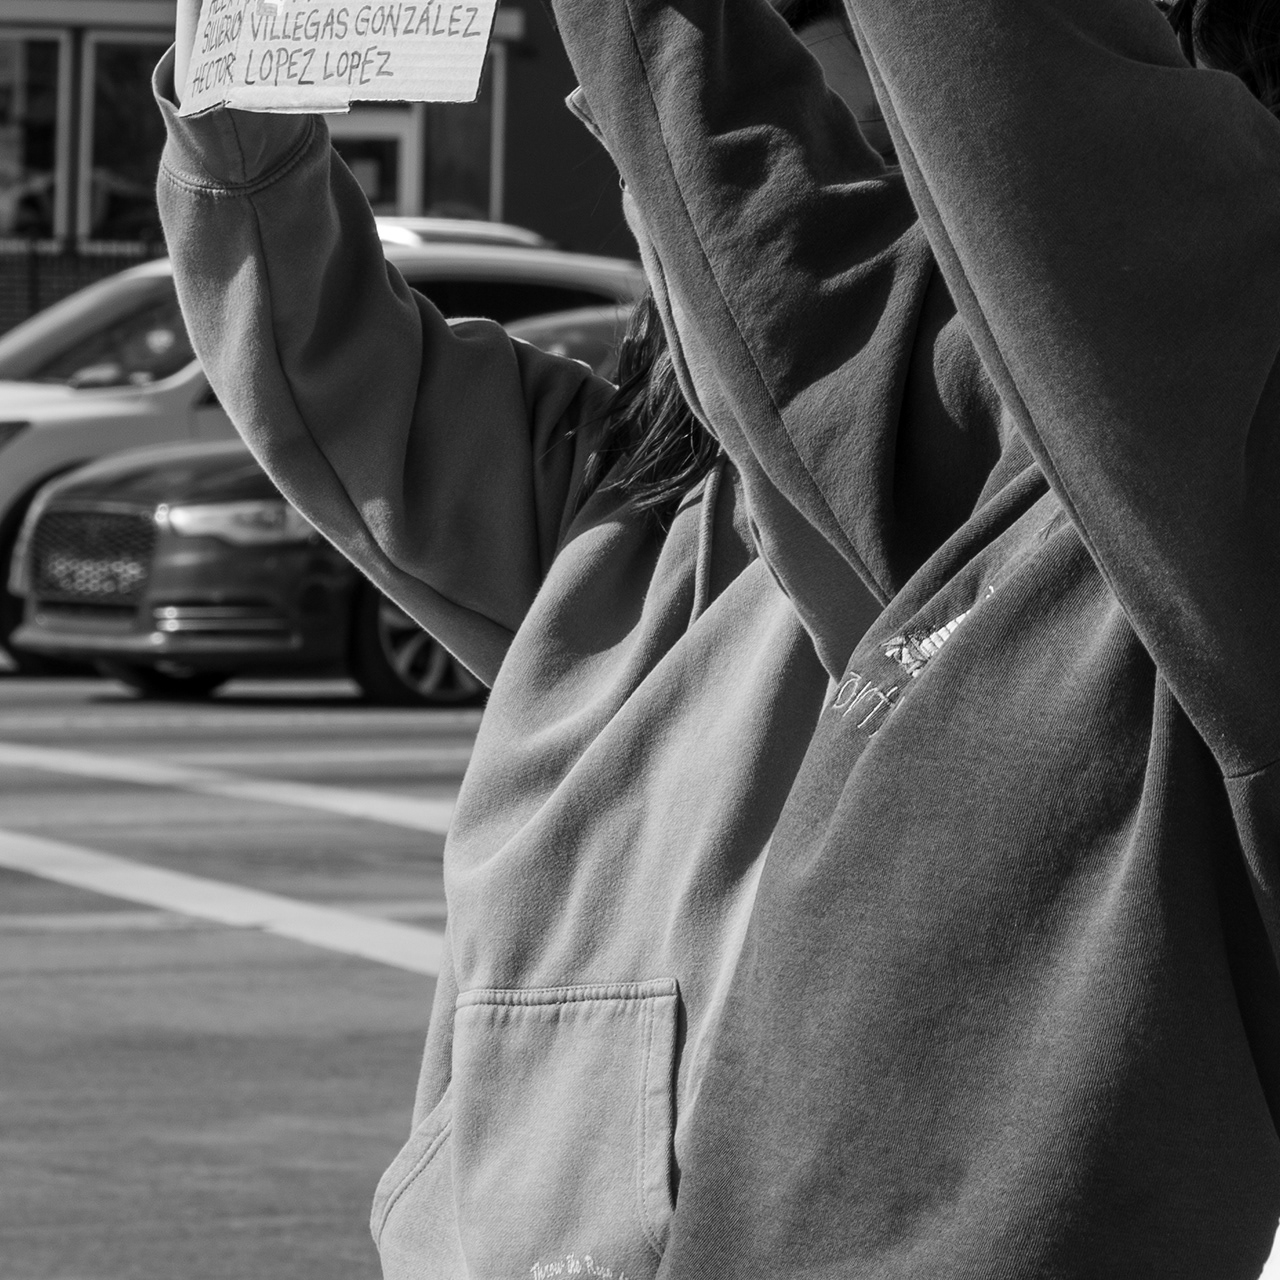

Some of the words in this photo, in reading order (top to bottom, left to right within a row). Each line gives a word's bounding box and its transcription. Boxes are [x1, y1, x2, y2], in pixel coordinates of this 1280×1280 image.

[251, 4, 350, 43] VILLEGAS
[244, 46, 316, 87] LOPEZ
[323, 45, 394, 85] LOPEZ
